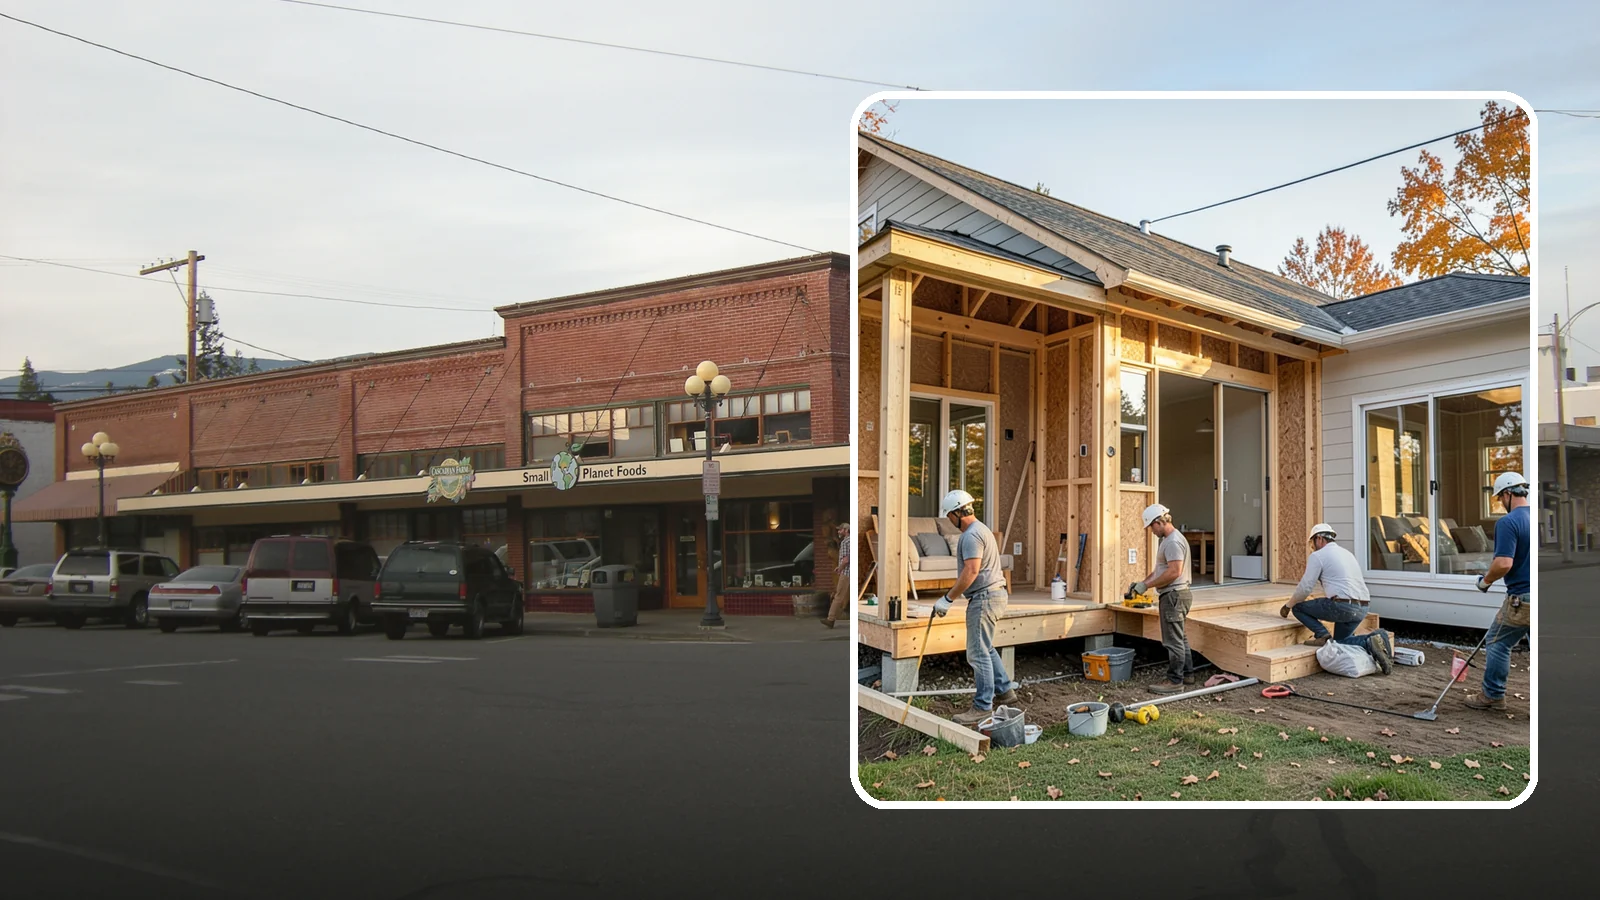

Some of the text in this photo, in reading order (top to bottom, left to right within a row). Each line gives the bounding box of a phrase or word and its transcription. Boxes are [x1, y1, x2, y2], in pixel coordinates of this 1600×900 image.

[456, 465, 469, 475] FARM
[523, 464, 647, 483] Small Planet Foods
